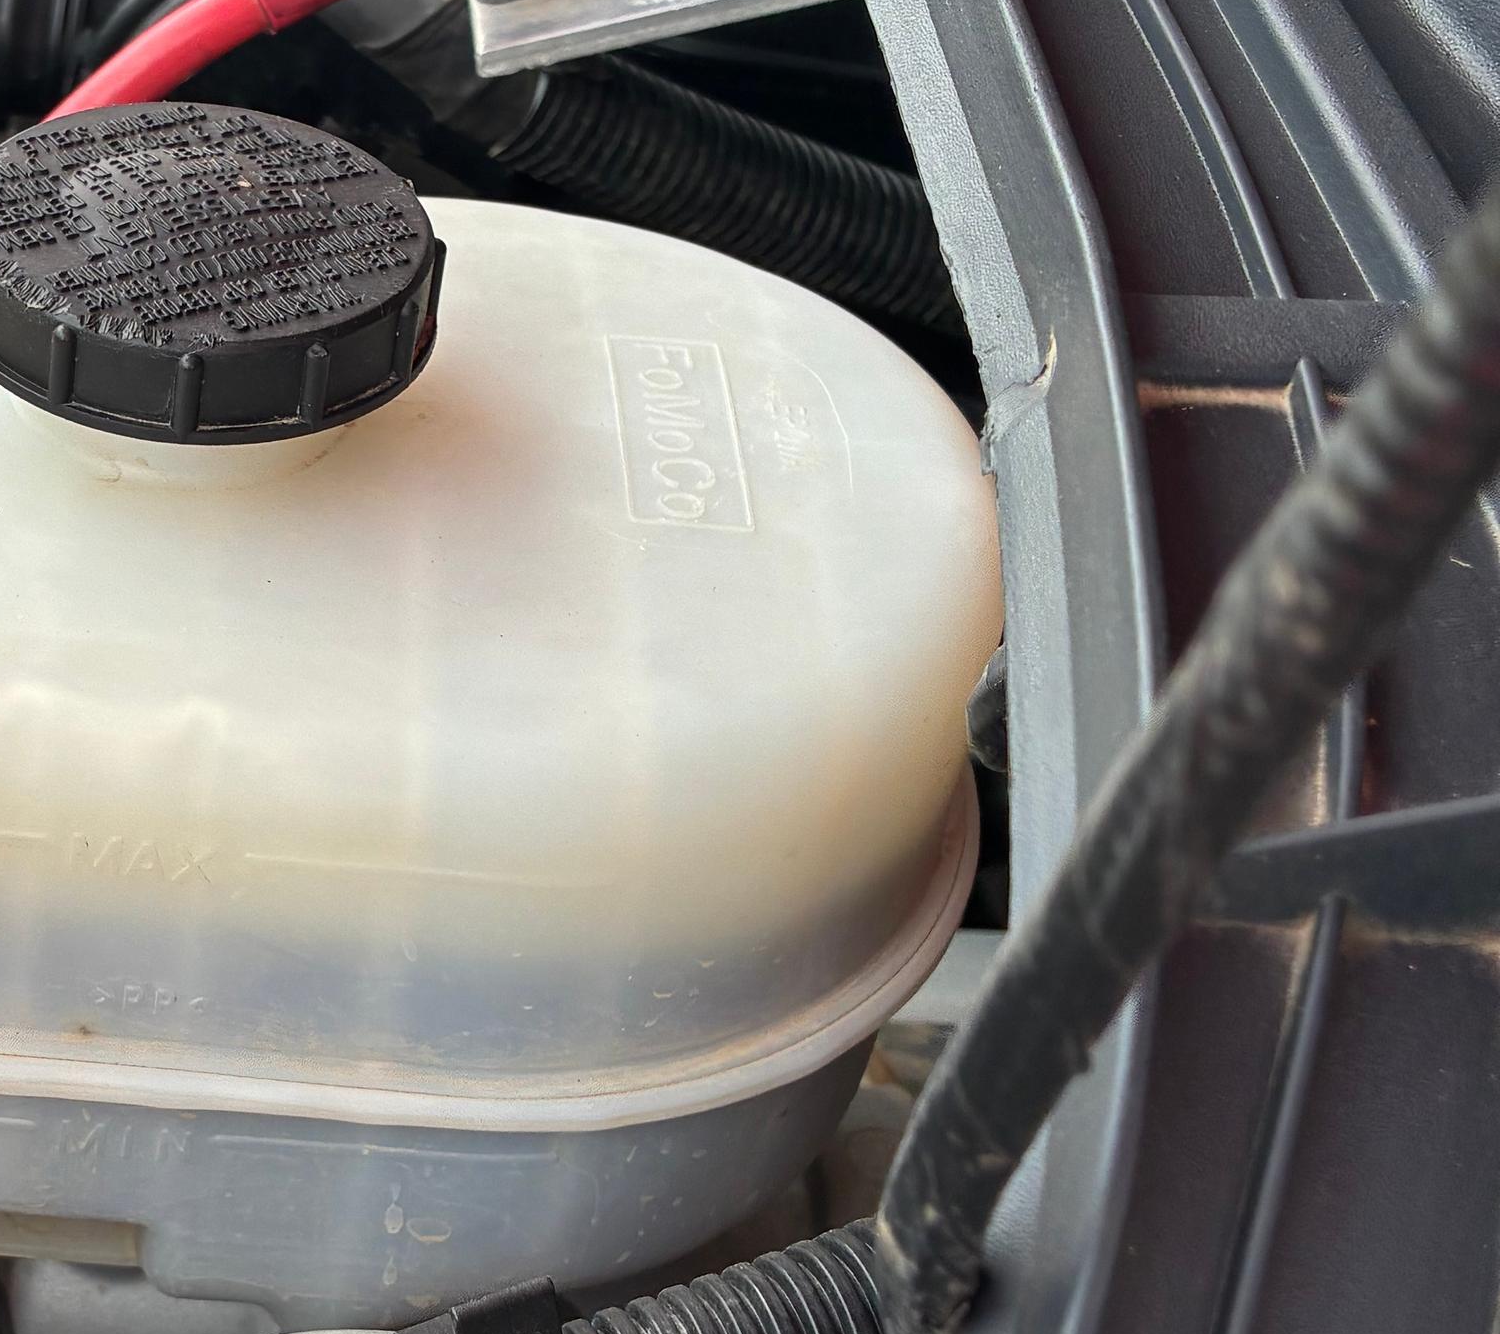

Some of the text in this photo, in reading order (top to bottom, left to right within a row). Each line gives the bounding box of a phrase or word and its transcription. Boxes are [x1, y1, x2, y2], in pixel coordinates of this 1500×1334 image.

[97, 105, 207, 141] CONTENANT
[212, 116, 262, 139] DOT
[52, 130, 190, 171] PROVENANT
[75, 167, 113, 186] DU
[89, 181, 127, 202] LE
[97, 178, 218, 222] BOUCHON
[52, 215, 96, 241] DE
[78, 185, 335, 262] AVERTISSEMENT
[44, 198, 403, 294] FLUID FROM A SEALED CONTAINER
[212, 246, 268, 279] ONLY
[267, 239, 315, 265] USE
[134, 247, 409, 325] CLEAN FILLER CAP BEFORE
[165, 259, 213, 292] DOT
[220, 283, 365, 330] WARNING
[632, 343, 716, 518] FoMoCo
[67, 831, 220, 885] MAX
[56, 1118, 193, 1160] MIN
